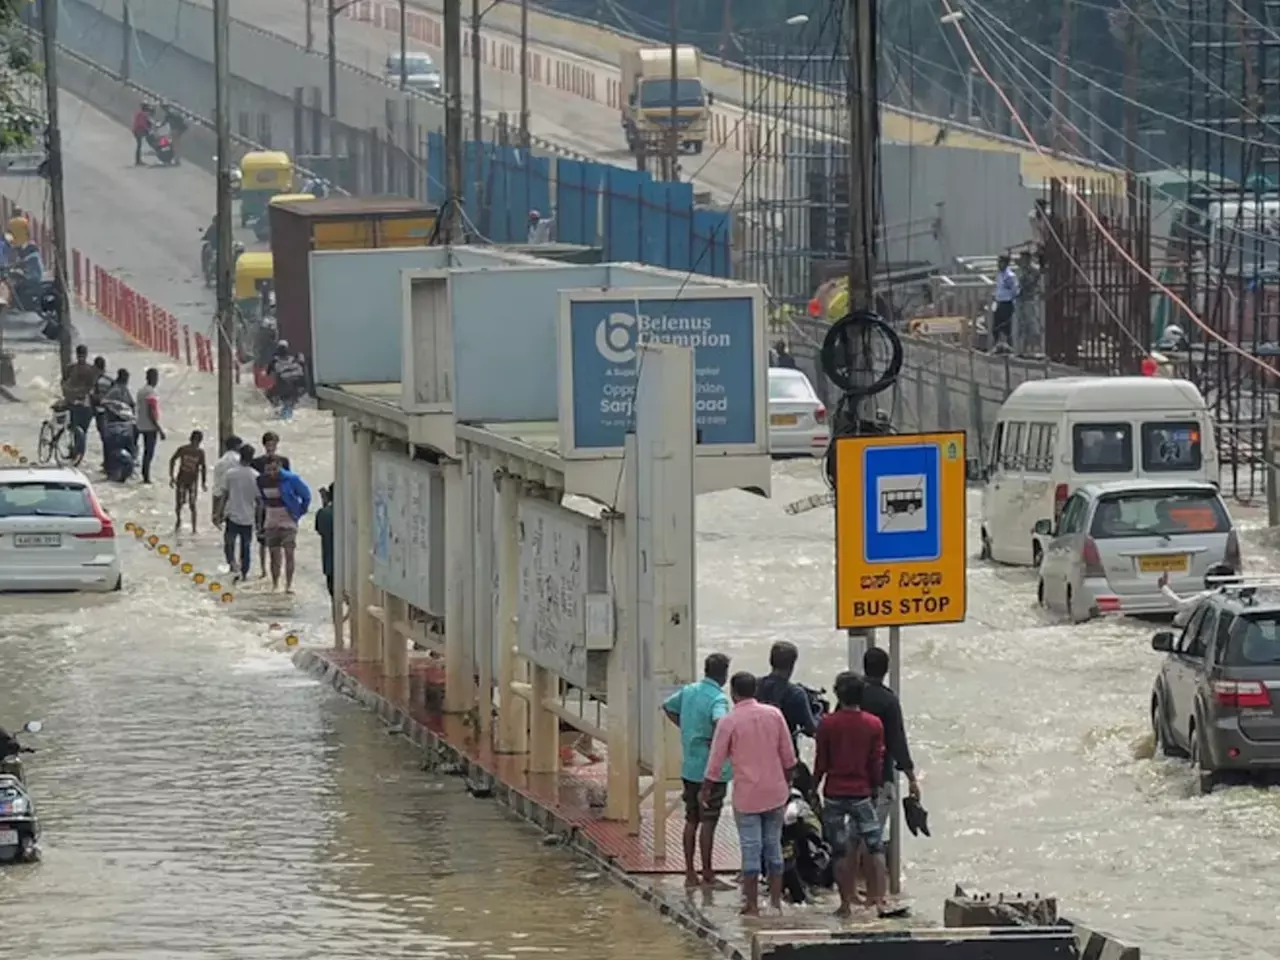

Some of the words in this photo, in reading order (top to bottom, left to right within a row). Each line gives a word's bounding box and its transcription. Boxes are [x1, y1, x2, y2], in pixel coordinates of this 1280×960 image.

[637, 314, 712, 331] Belenus
[637, 331, 731, 348] Champion
[600, 398, 637, 416] Sarj
[695, 397, 727, 411] oad
[860, 569, 890, 590] ಬಸ್
[854, 600, 892, 617] BUS
[899, 596, 950, 615] STOP
